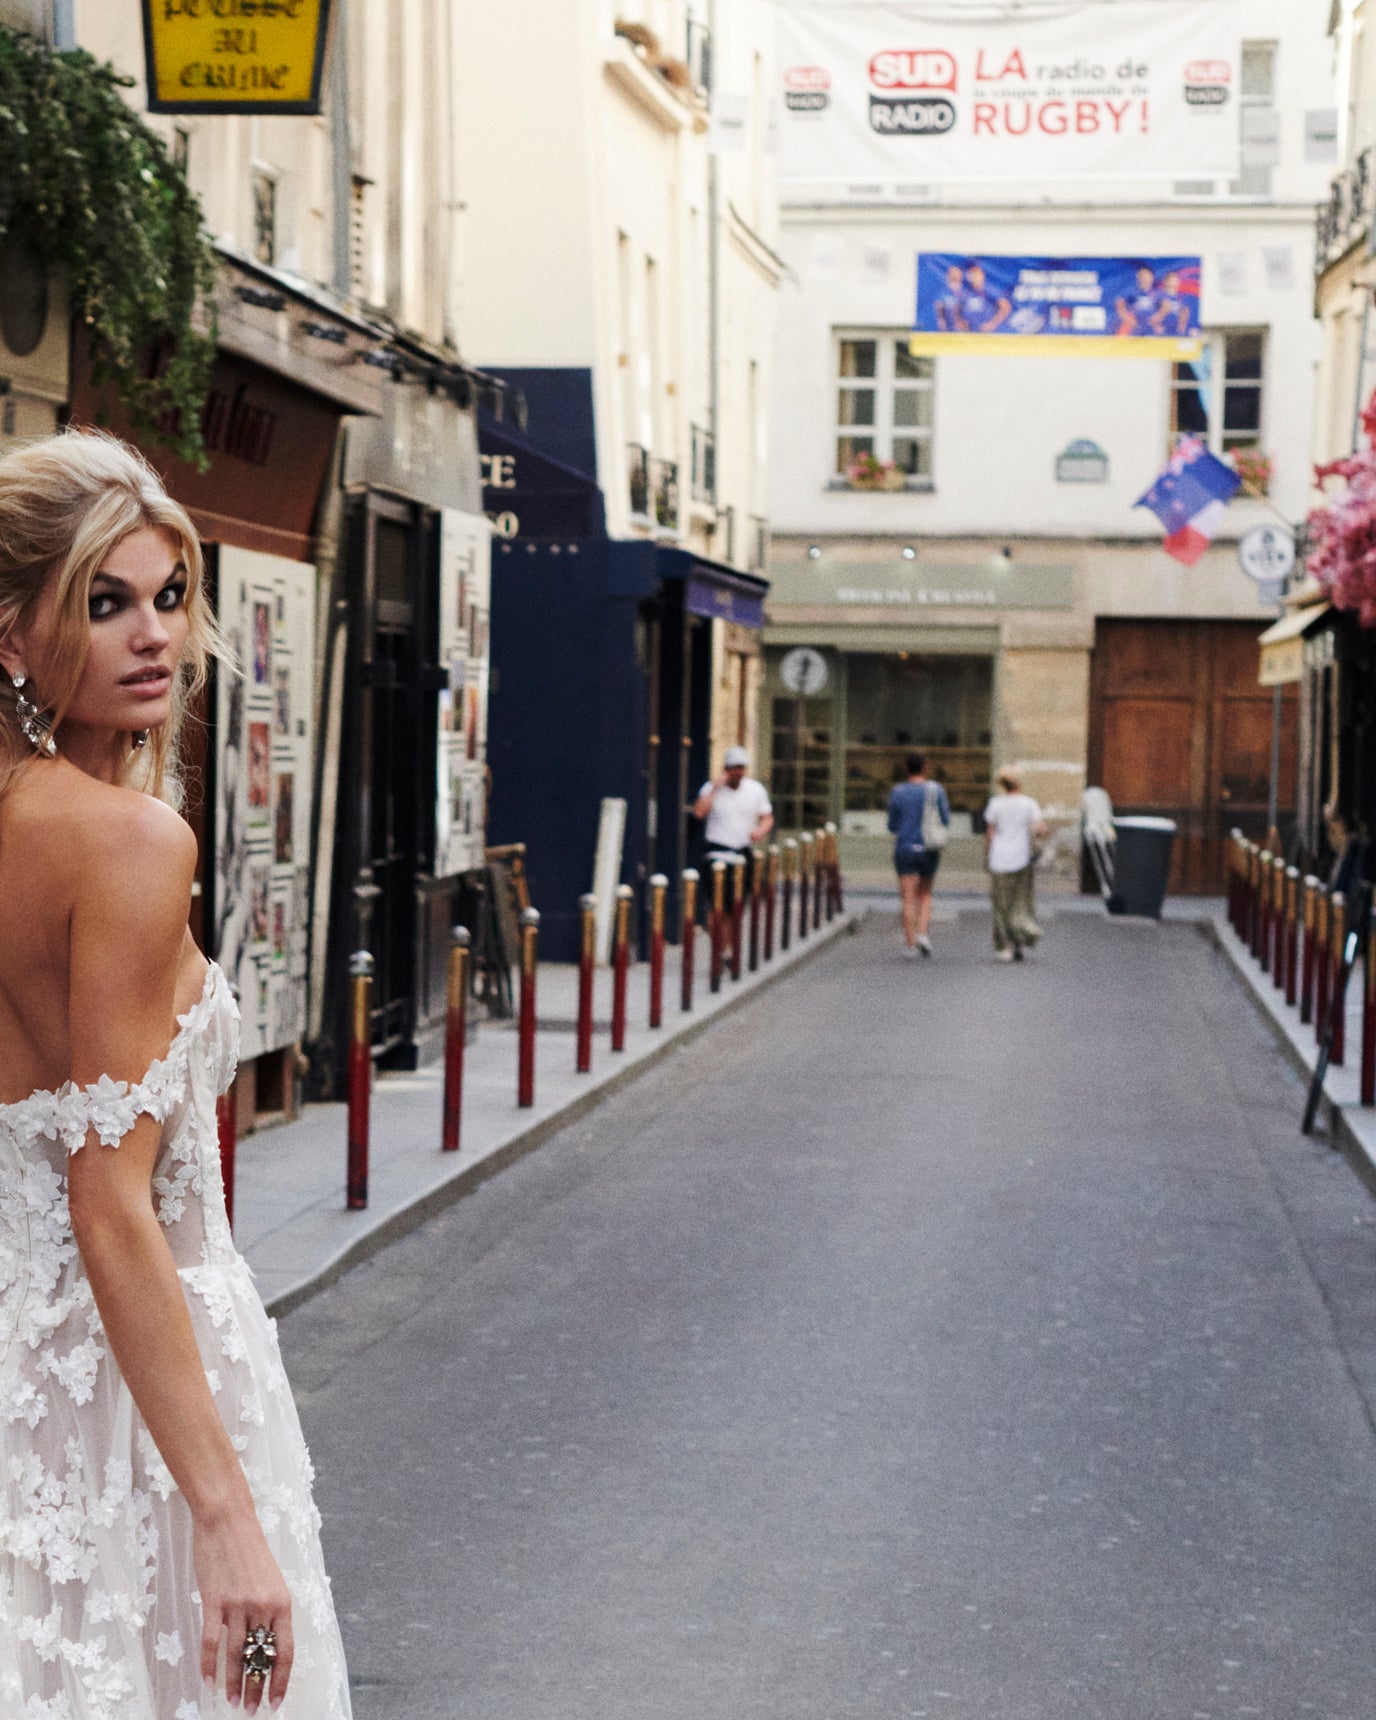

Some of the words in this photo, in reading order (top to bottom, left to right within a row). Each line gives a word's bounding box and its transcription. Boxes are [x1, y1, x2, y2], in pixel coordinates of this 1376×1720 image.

[874, 52, 954, 88] SUD
[975, 48, 1029, 81] LA
[1036, 58, 1106, 81] radio
[1117, 57, 1150, 80] de
[871, 103, 954, 130] RADIO
